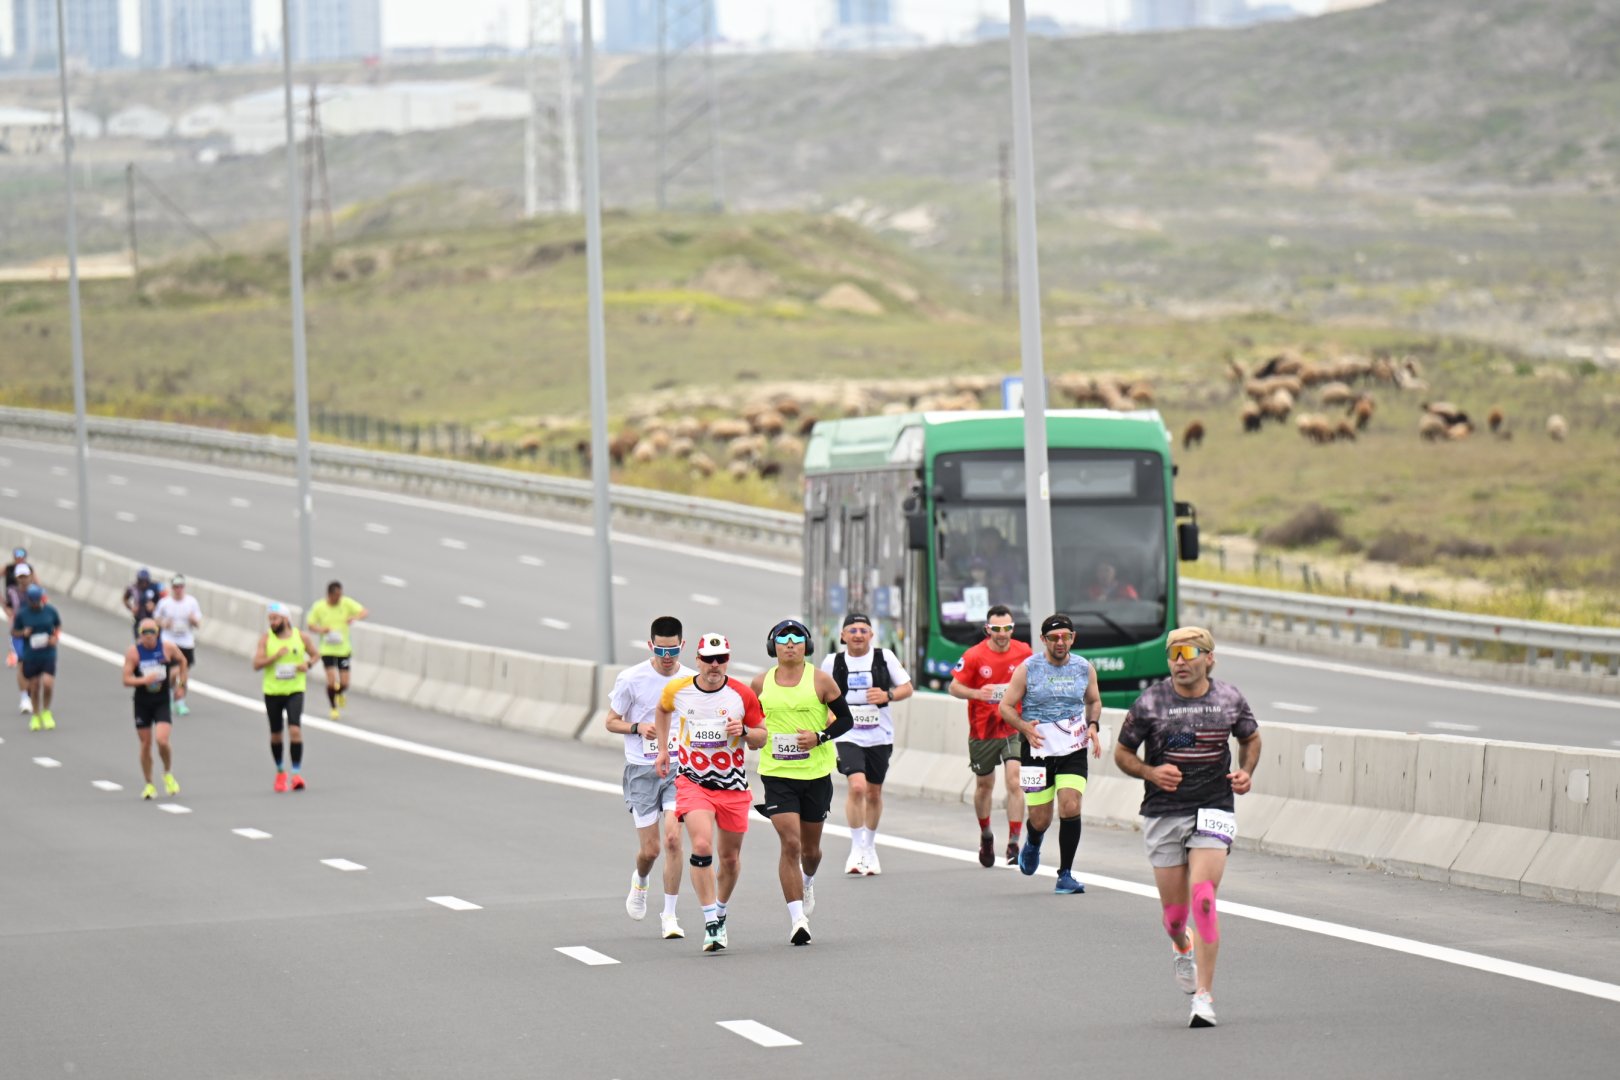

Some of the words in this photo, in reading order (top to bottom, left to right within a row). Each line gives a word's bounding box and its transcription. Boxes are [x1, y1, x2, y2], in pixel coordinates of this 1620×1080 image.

[1168, 706, 1204, 715] AMERICAN
[1205, 704, 1222, 713] FLAG
[694, 730, 722, 740] 4886
[1204, 818, 1235, 837] 13952
